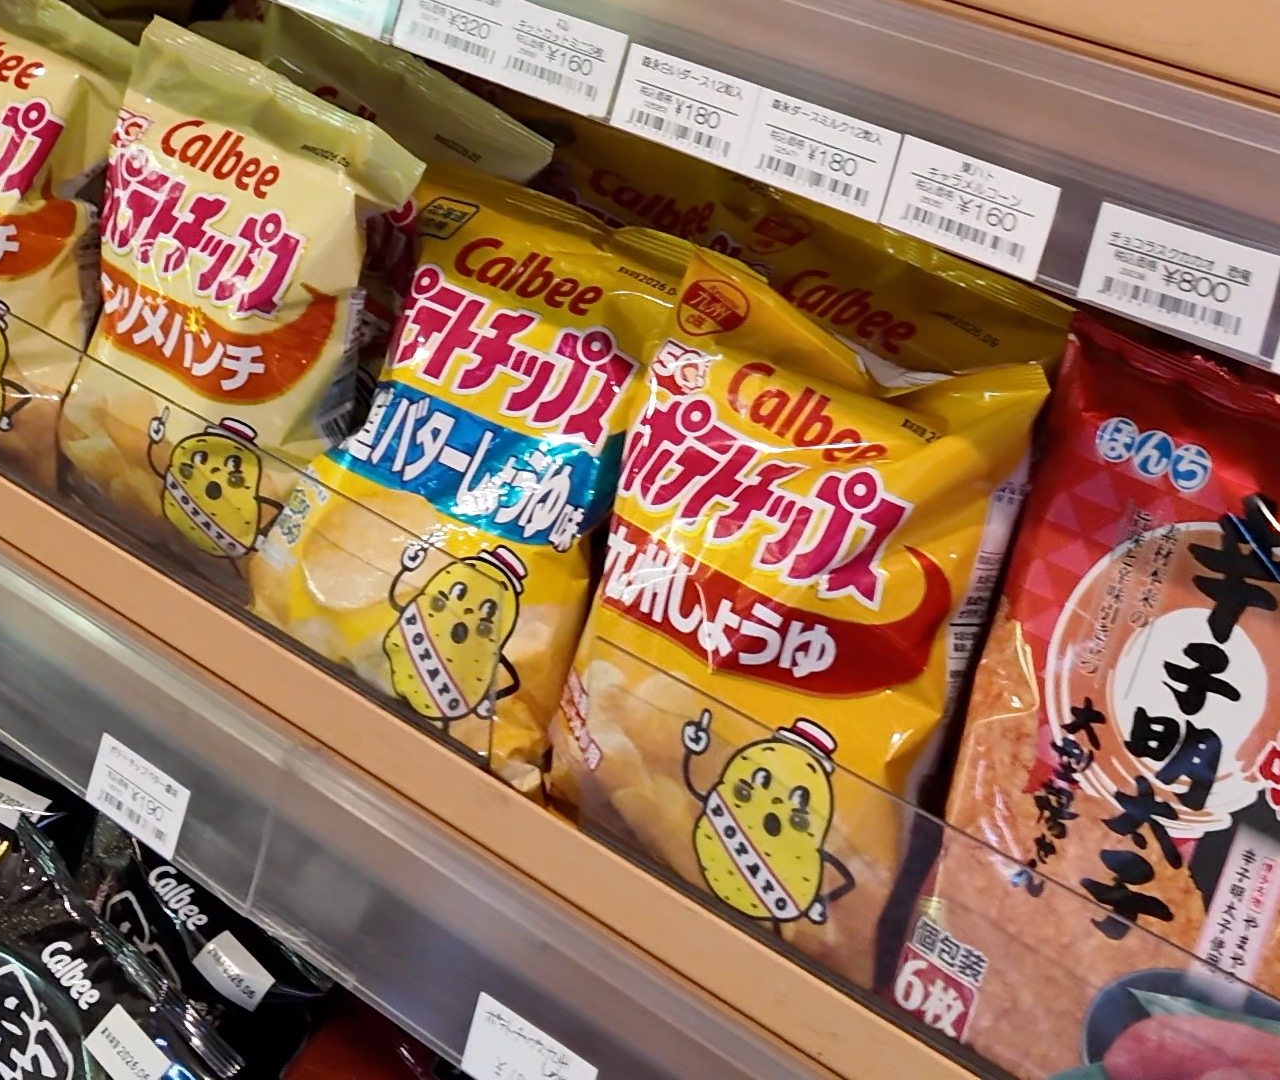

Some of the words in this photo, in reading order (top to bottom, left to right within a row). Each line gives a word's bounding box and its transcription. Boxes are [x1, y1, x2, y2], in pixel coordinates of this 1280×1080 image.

[446, 10, 492, 42] ¥320
[544, 43, 594, 79] ¥160
[671, 97, 722, 131] ¥180
[159, 119, 281, 201] Calbee
[805, 143, 860, 180] ¥180
[953, 194, 1019, 235] ¥160
[454, 237, 605, 319] Calbee
[1157, 263, 1232, 306] ¥800
[725, 363, 889, 464] Calbee
[619, 398, 914, 611] ポテトチップス
[148, 865, 209, 931] Calbee
[41, 939, 101, 1012] Calbee
